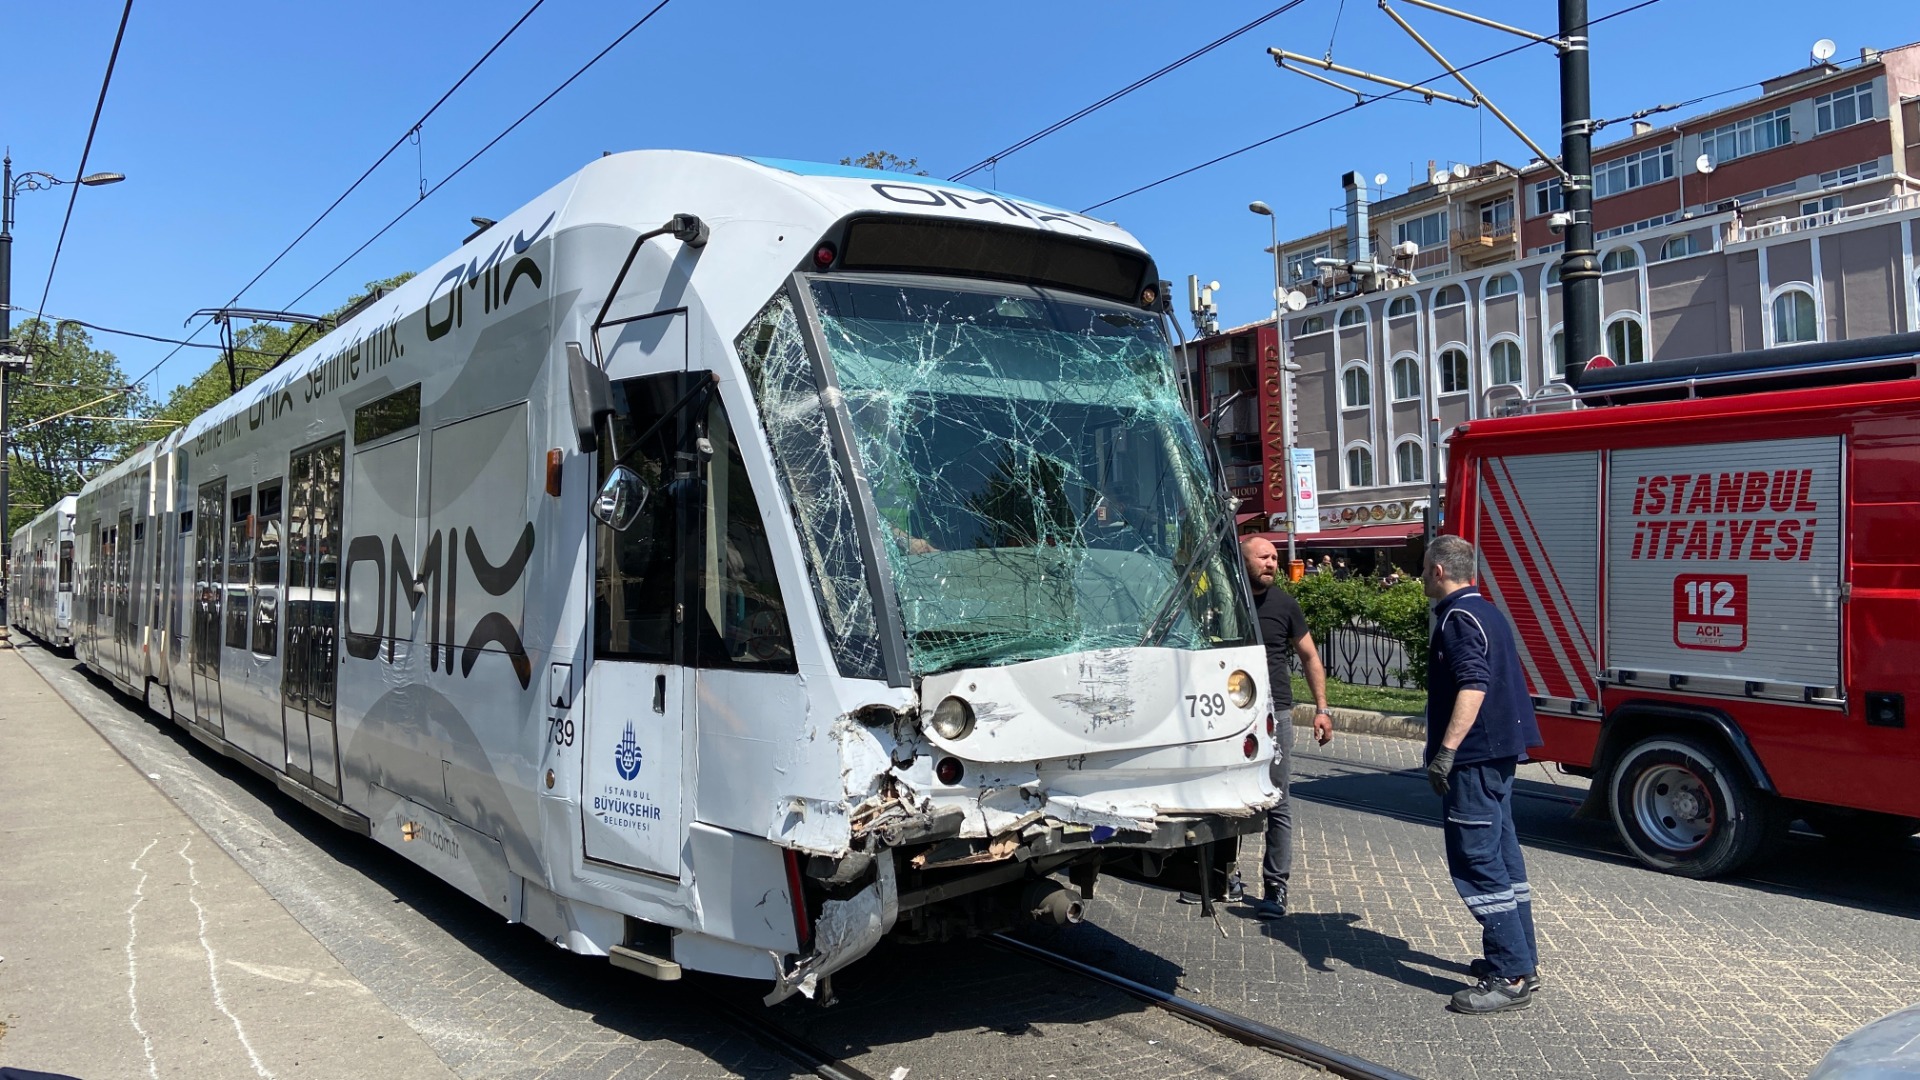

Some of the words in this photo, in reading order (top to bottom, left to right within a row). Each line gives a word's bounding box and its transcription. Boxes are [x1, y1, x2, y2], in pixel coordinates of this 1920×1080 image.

[871, 184, 1092, 231] OMIX
[248, 362, 304, 431] OMIX
[426, 210, 556, 341] OMIX
[1266, 402, 1283, 501] OSMANLI
[344, 521, 535, 690] OMIX
[1684, 581, 1735, 617] 112
[1185, 693, 1226, 717] 739
[547, 717, 575, 747] 739
[1207, 721, 1214, 730] A
[594, 796, 661, 820] BÜYÜKŞEHİR
